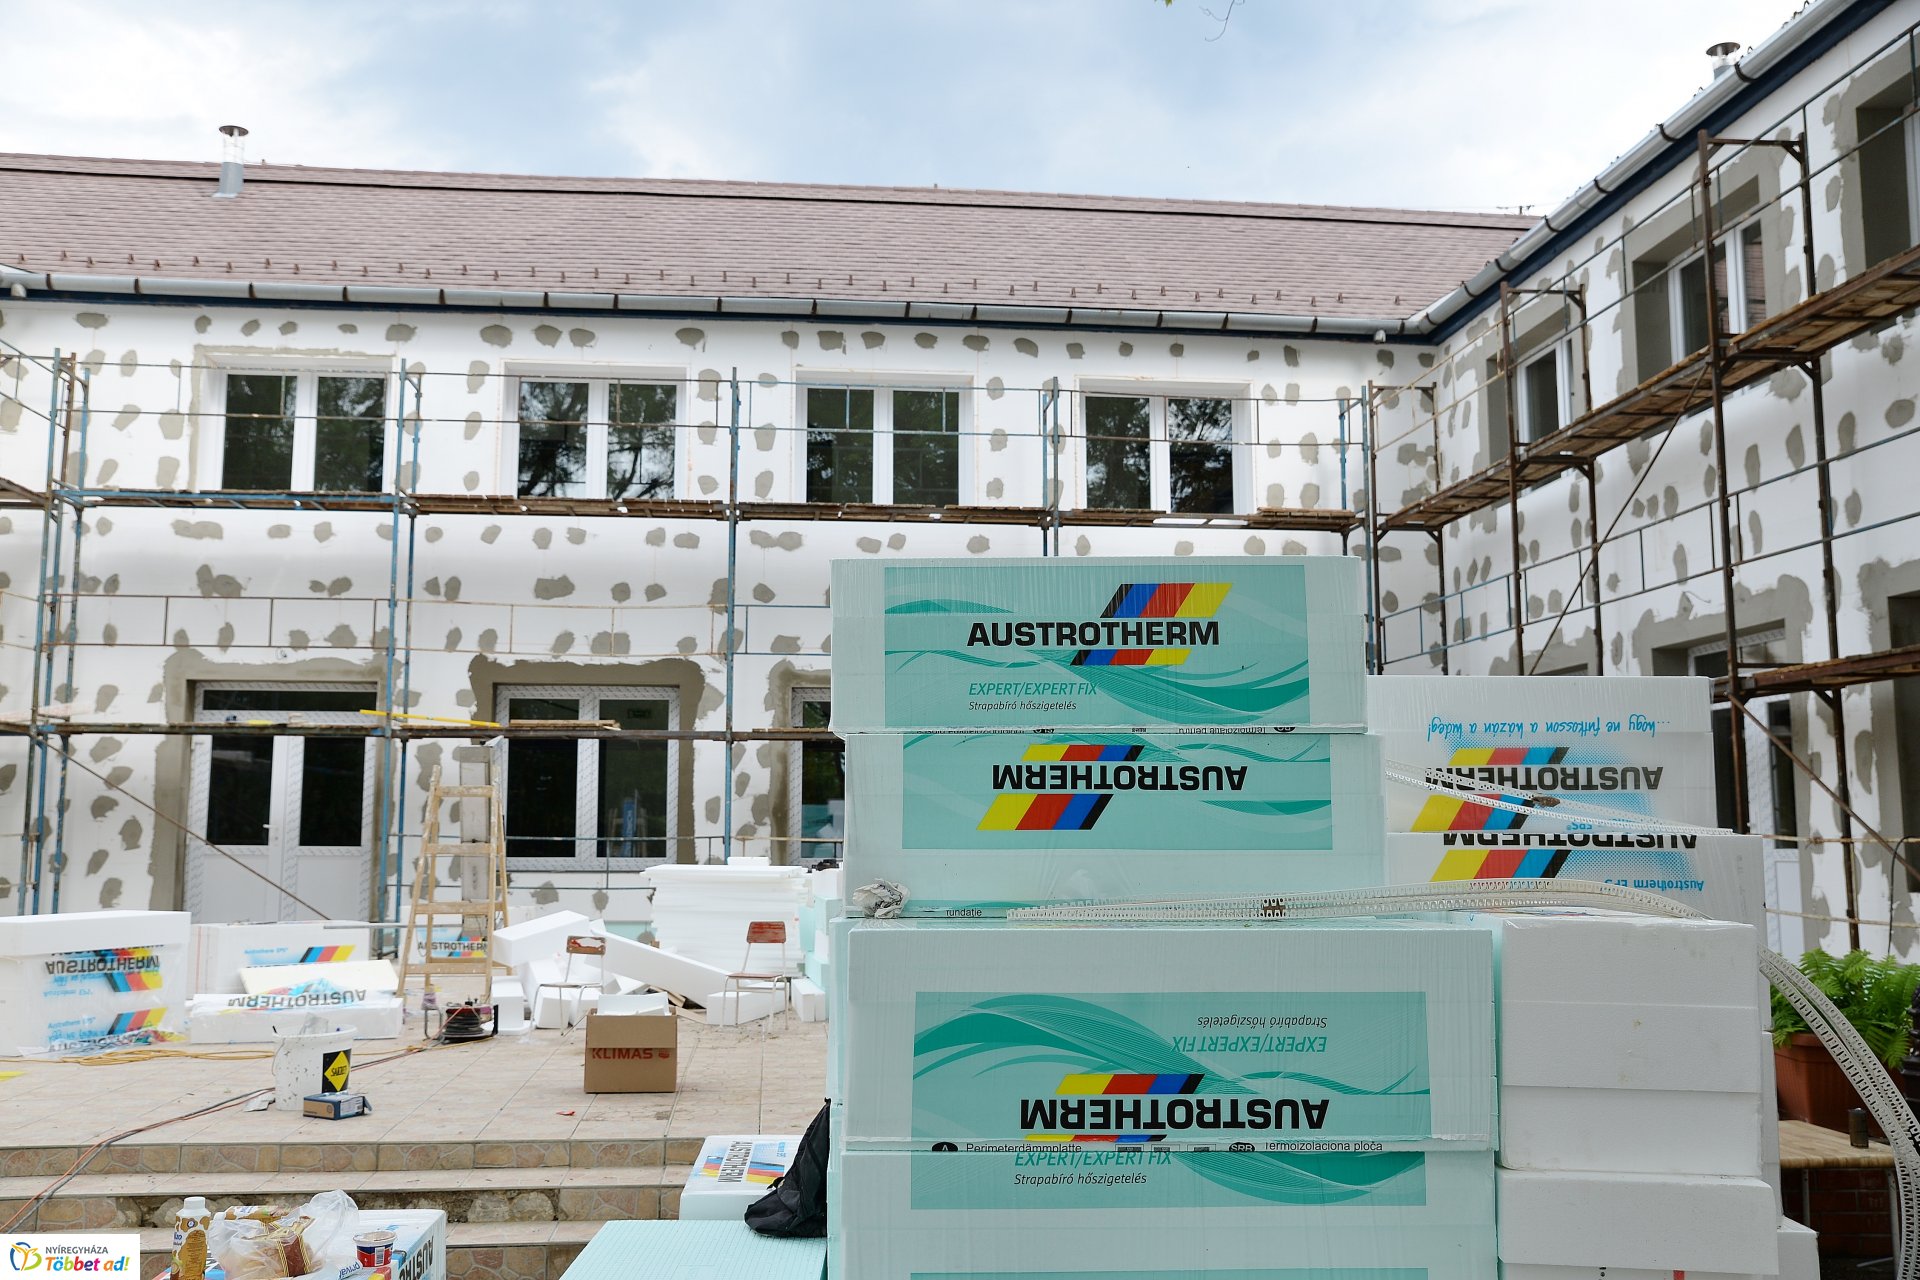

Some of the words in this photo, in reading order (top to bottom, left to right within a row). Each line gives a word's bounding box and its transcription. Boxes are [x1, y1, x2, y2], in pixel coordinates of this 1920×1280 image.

[967, 622, 1220, 647] AUSTROTHERM
[969, 682, 1077, 697] EXPERT/EXPERT
[1078, 683, 1097, 695] FIX
[969, 701, 1017, 712] Strapabíró
[1020, 701, 1077, 711] hőszigetelés
[1469, 723, 1477, 733] a
[1484, 722, 1524, 736] házán
[1530, 723, 1539, 733] a
[1606, 723, 1620, 732] ne
[993, 765, 1248, 790] AUSTROTHERM
[1633, 880, 1704, 891] Austrotherm
[417, 942, 488, 951] ASTROTHER
[228, 989, 366, 1007] AUSTROTHERM
[1198, 1015, 1266, 1029] hőszigetelés
[1269, 1017, 1327, 1029] Strapabíró
[1172, 1036, 1196, 1052] FIX
[1197, 1033, 1328, 1053] EXPERT/EXPERT
[592, 1048, 653, 1059] KLIMAS
[1020, 1098, 1330, 1130] AUSTROTHERM
[1014, 1151, 1143, 1168] EXPERT/EXPERT
[1148, 1151, 1173, 1165] FIX
[1014, 1173, 1074, 1185] Strapabíró
[1077, 1172, 1147, 1186] hőszigetelés
